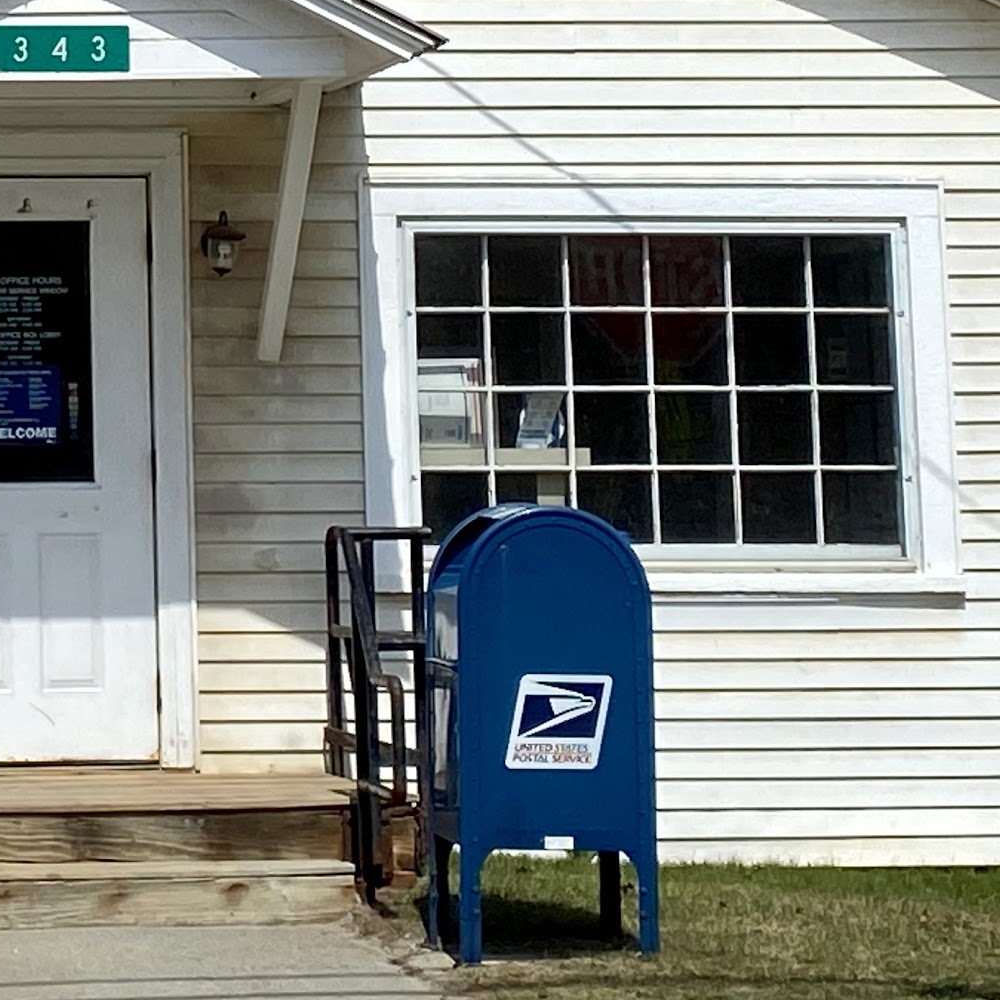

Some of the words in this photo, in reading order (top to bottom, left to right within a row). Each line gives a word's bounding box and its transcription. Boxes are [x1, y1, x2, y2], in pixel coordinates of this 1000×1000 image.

[0, 276, 31, 286] OFFICE
[32, 276, 63, 286] HOURS
[514, 743, 553, 752] UNITED
[555, 743, 589, 752] STATES
[512, 753, 549, 763] POSTAL
[552, 753, 592, 763] SERVICE
